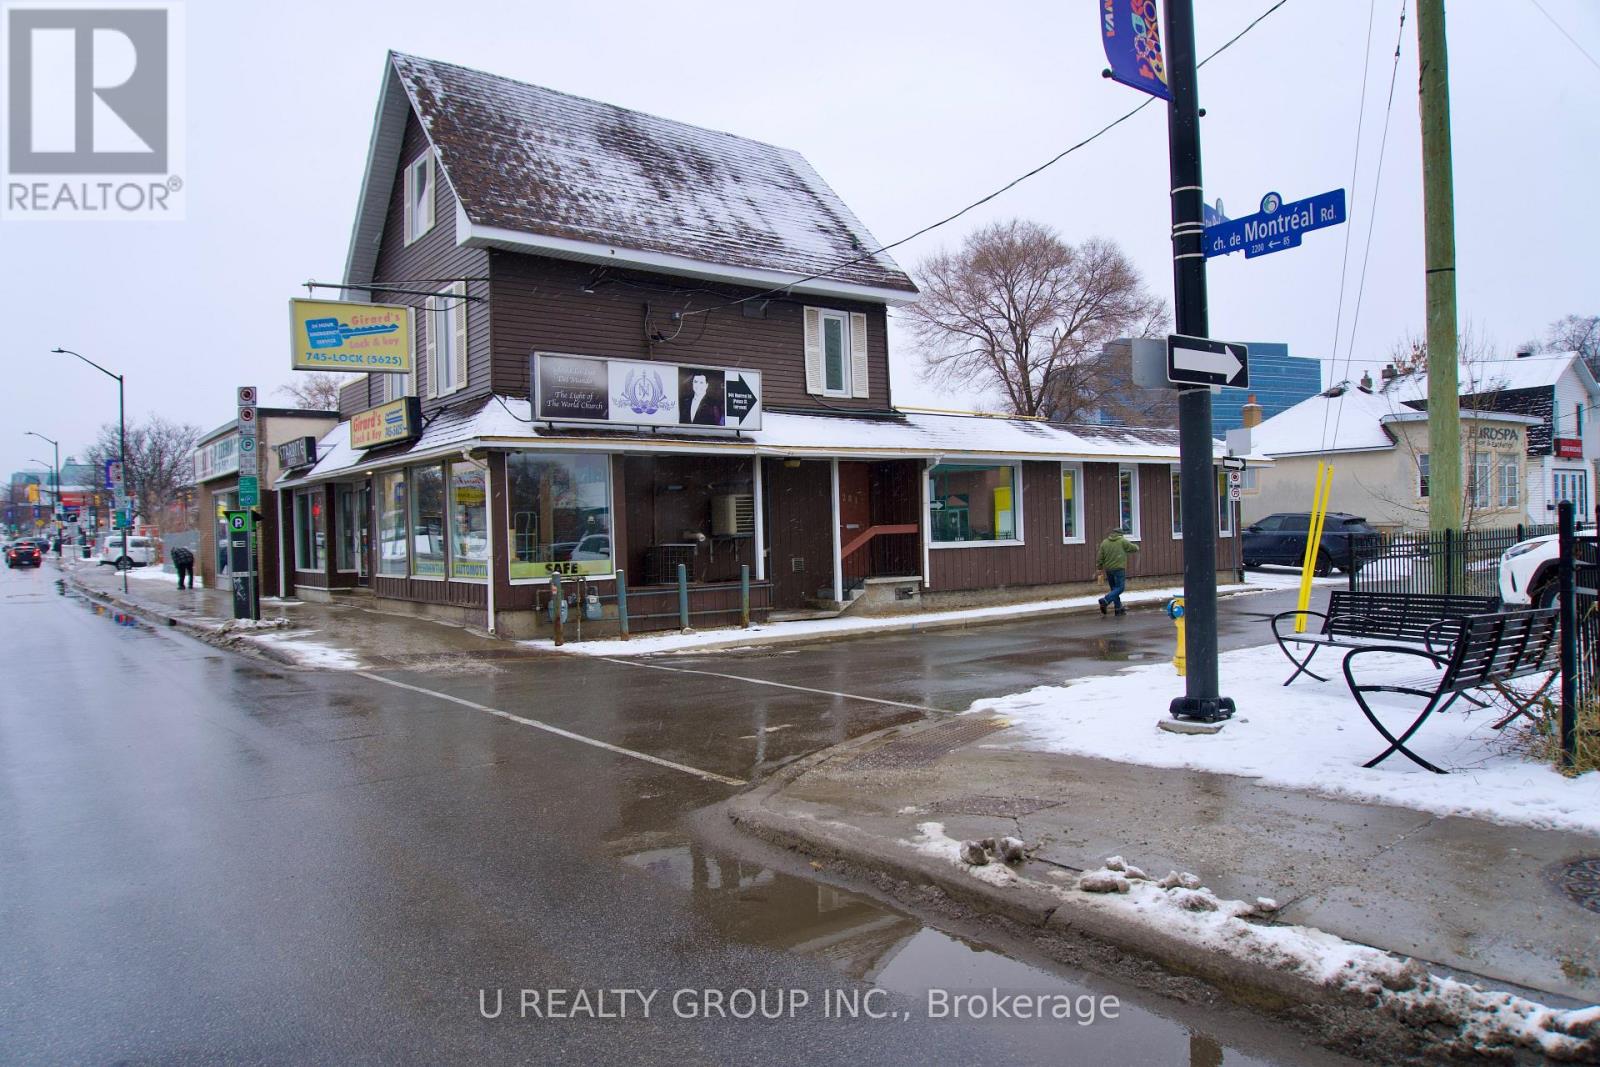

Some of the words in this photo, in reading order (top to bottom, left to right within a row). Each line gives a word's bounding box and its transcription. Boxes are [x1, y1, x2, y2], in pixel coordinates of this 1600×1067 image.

[1213, 236, 1226, 251] ch.
[1229, 232, 1241, 247] de
[1244, 203, 1314, 243] Montréal
[351, 311, 400, 325] Girard's
[373, 338, 380, 346] &
[305, 352, 363, 363] 745-LOCK
[367, 355, 402, 367] (5625)
[555, 390, 568, 398] The
[569, 391, 586, 402] Light
[547, 399, 560, 407] The
[560, 400, 580, 408] World
[580, 401, 603, 409] Church
[353, 410, 382, 433] Girard's
[545, 562, 578, 575] SAFE
